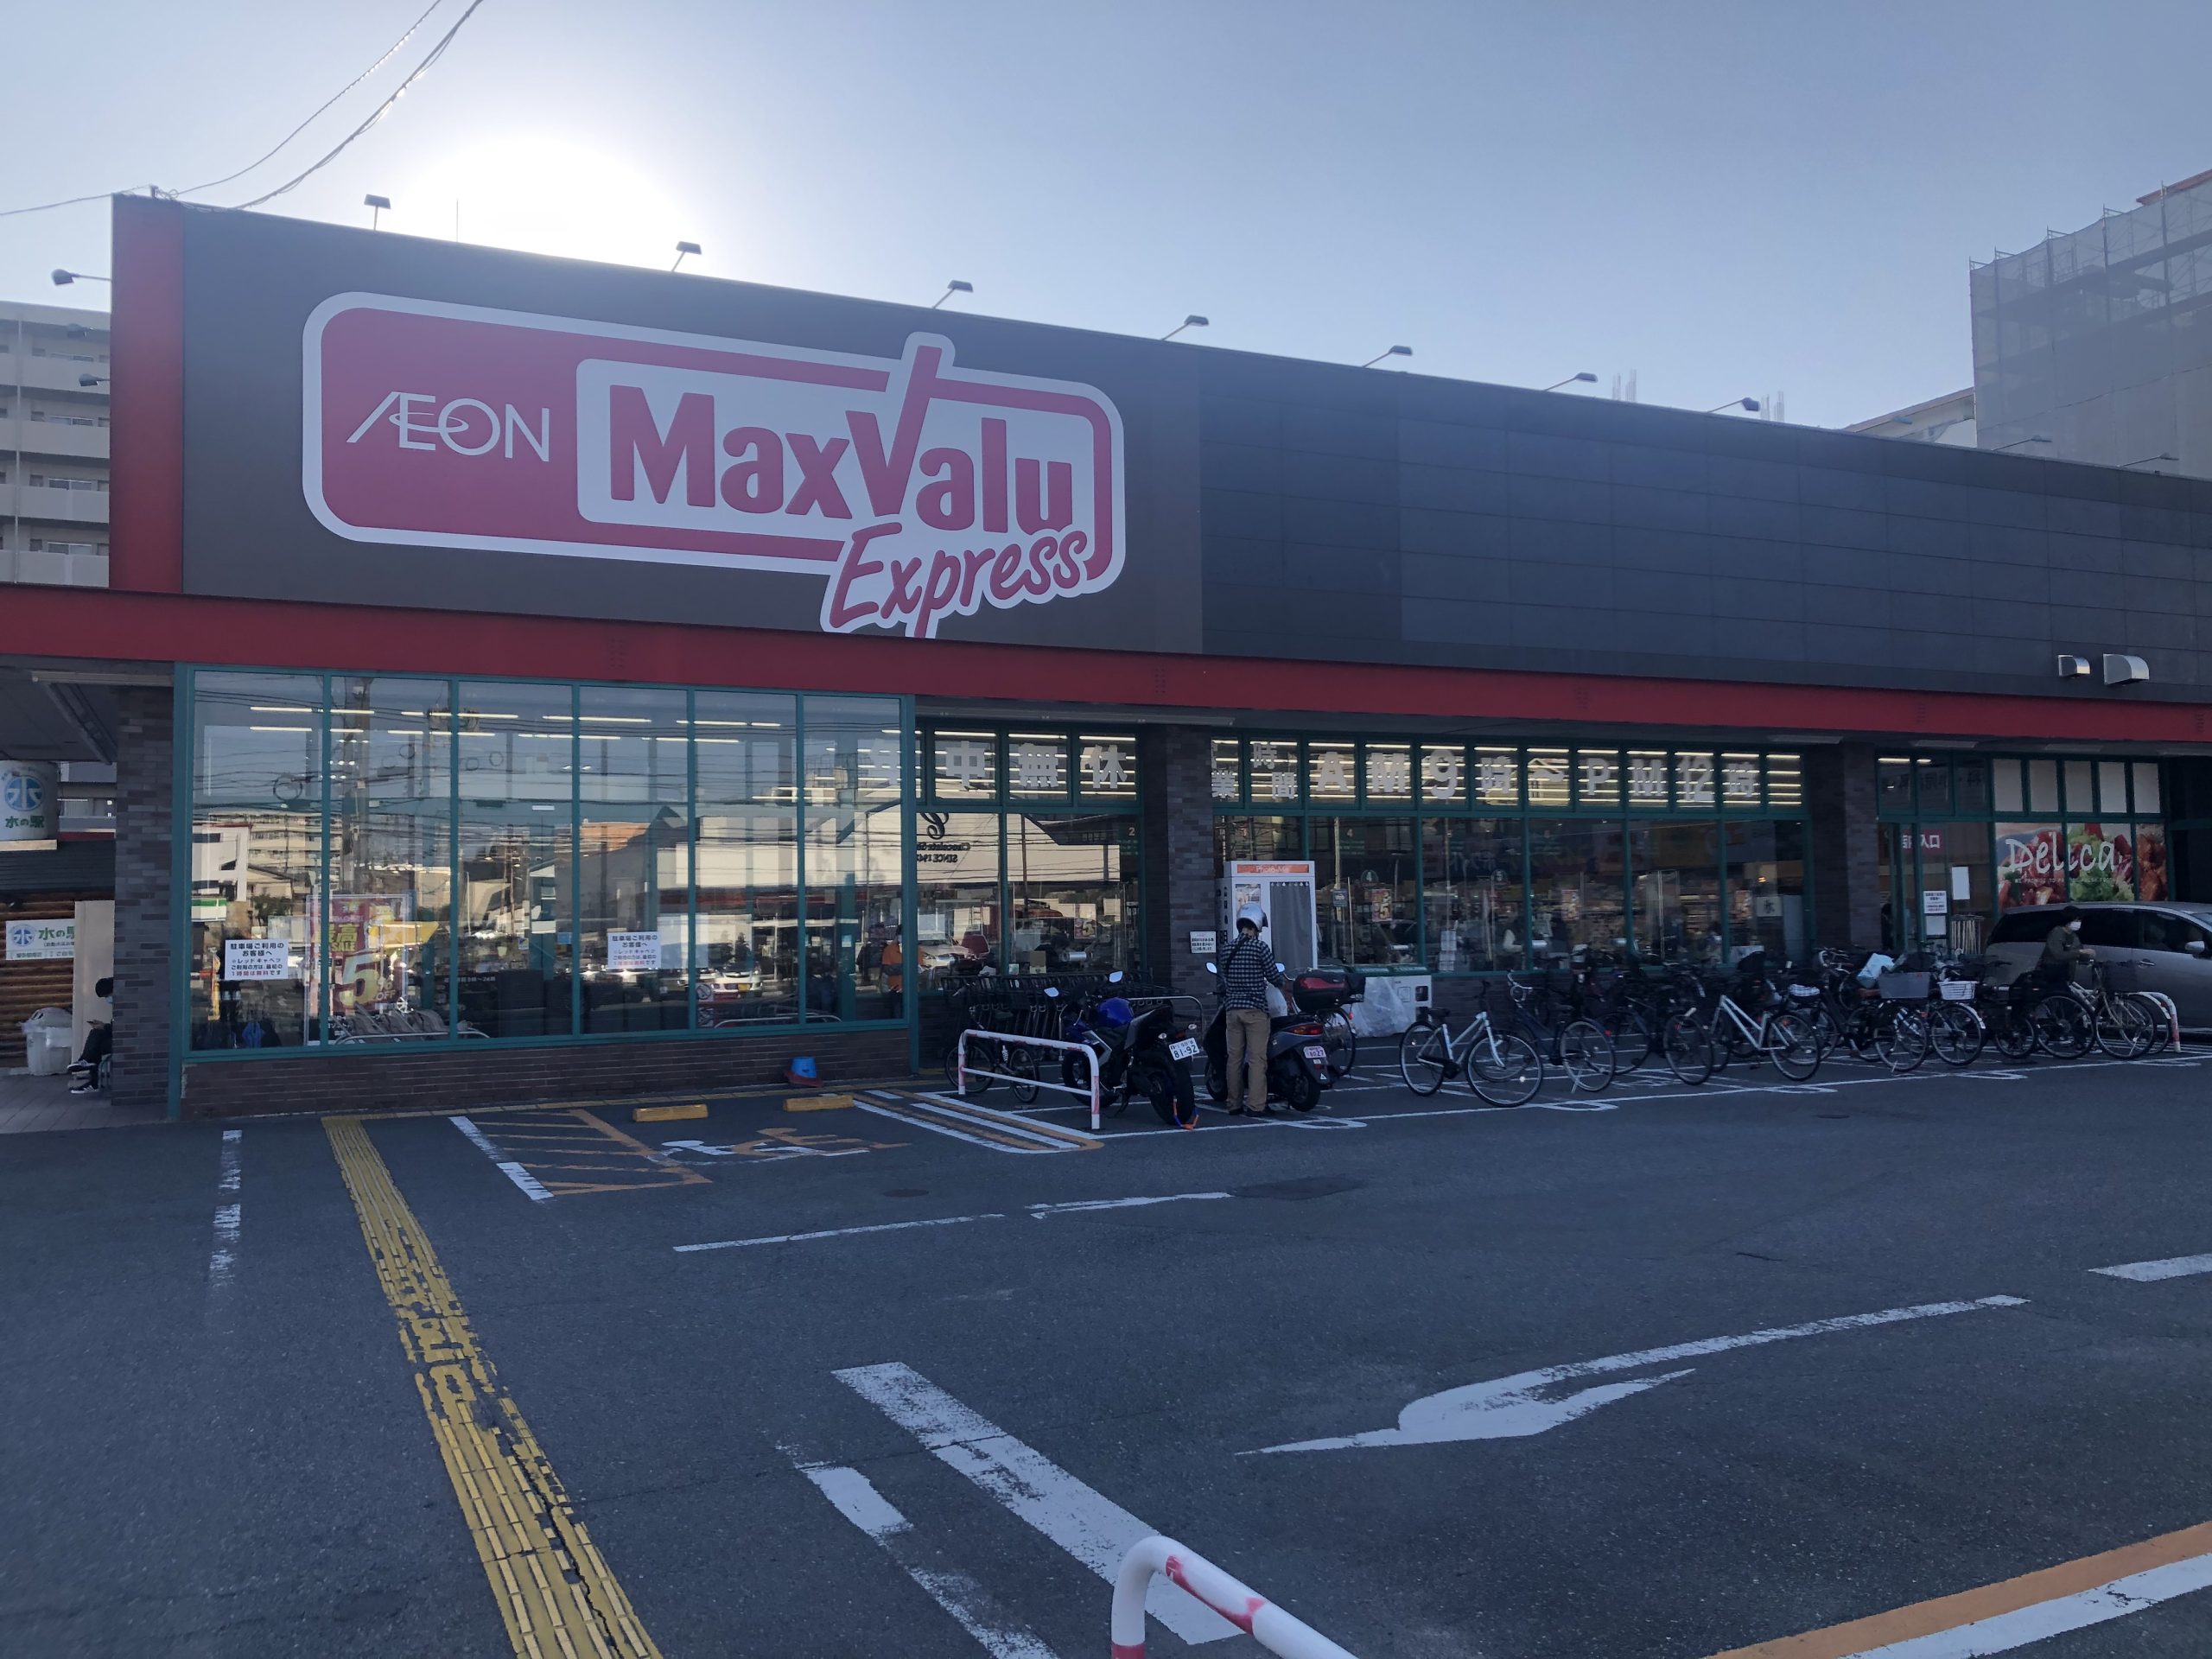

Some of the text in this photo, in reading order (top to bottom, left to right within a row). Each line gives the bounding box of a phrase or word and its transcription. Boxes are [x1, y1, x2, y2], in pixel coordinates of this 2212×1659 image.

[609, 345, 1074, 535] MaxValu
[830, 522, 1089, 639] Express
[1211, 741, 1295, 799] 業時間
[5, 816, 45, 828] 水の駅
[1128, 827, 1135, 836] 2
[1999, 831, 2115, 874] Delica
